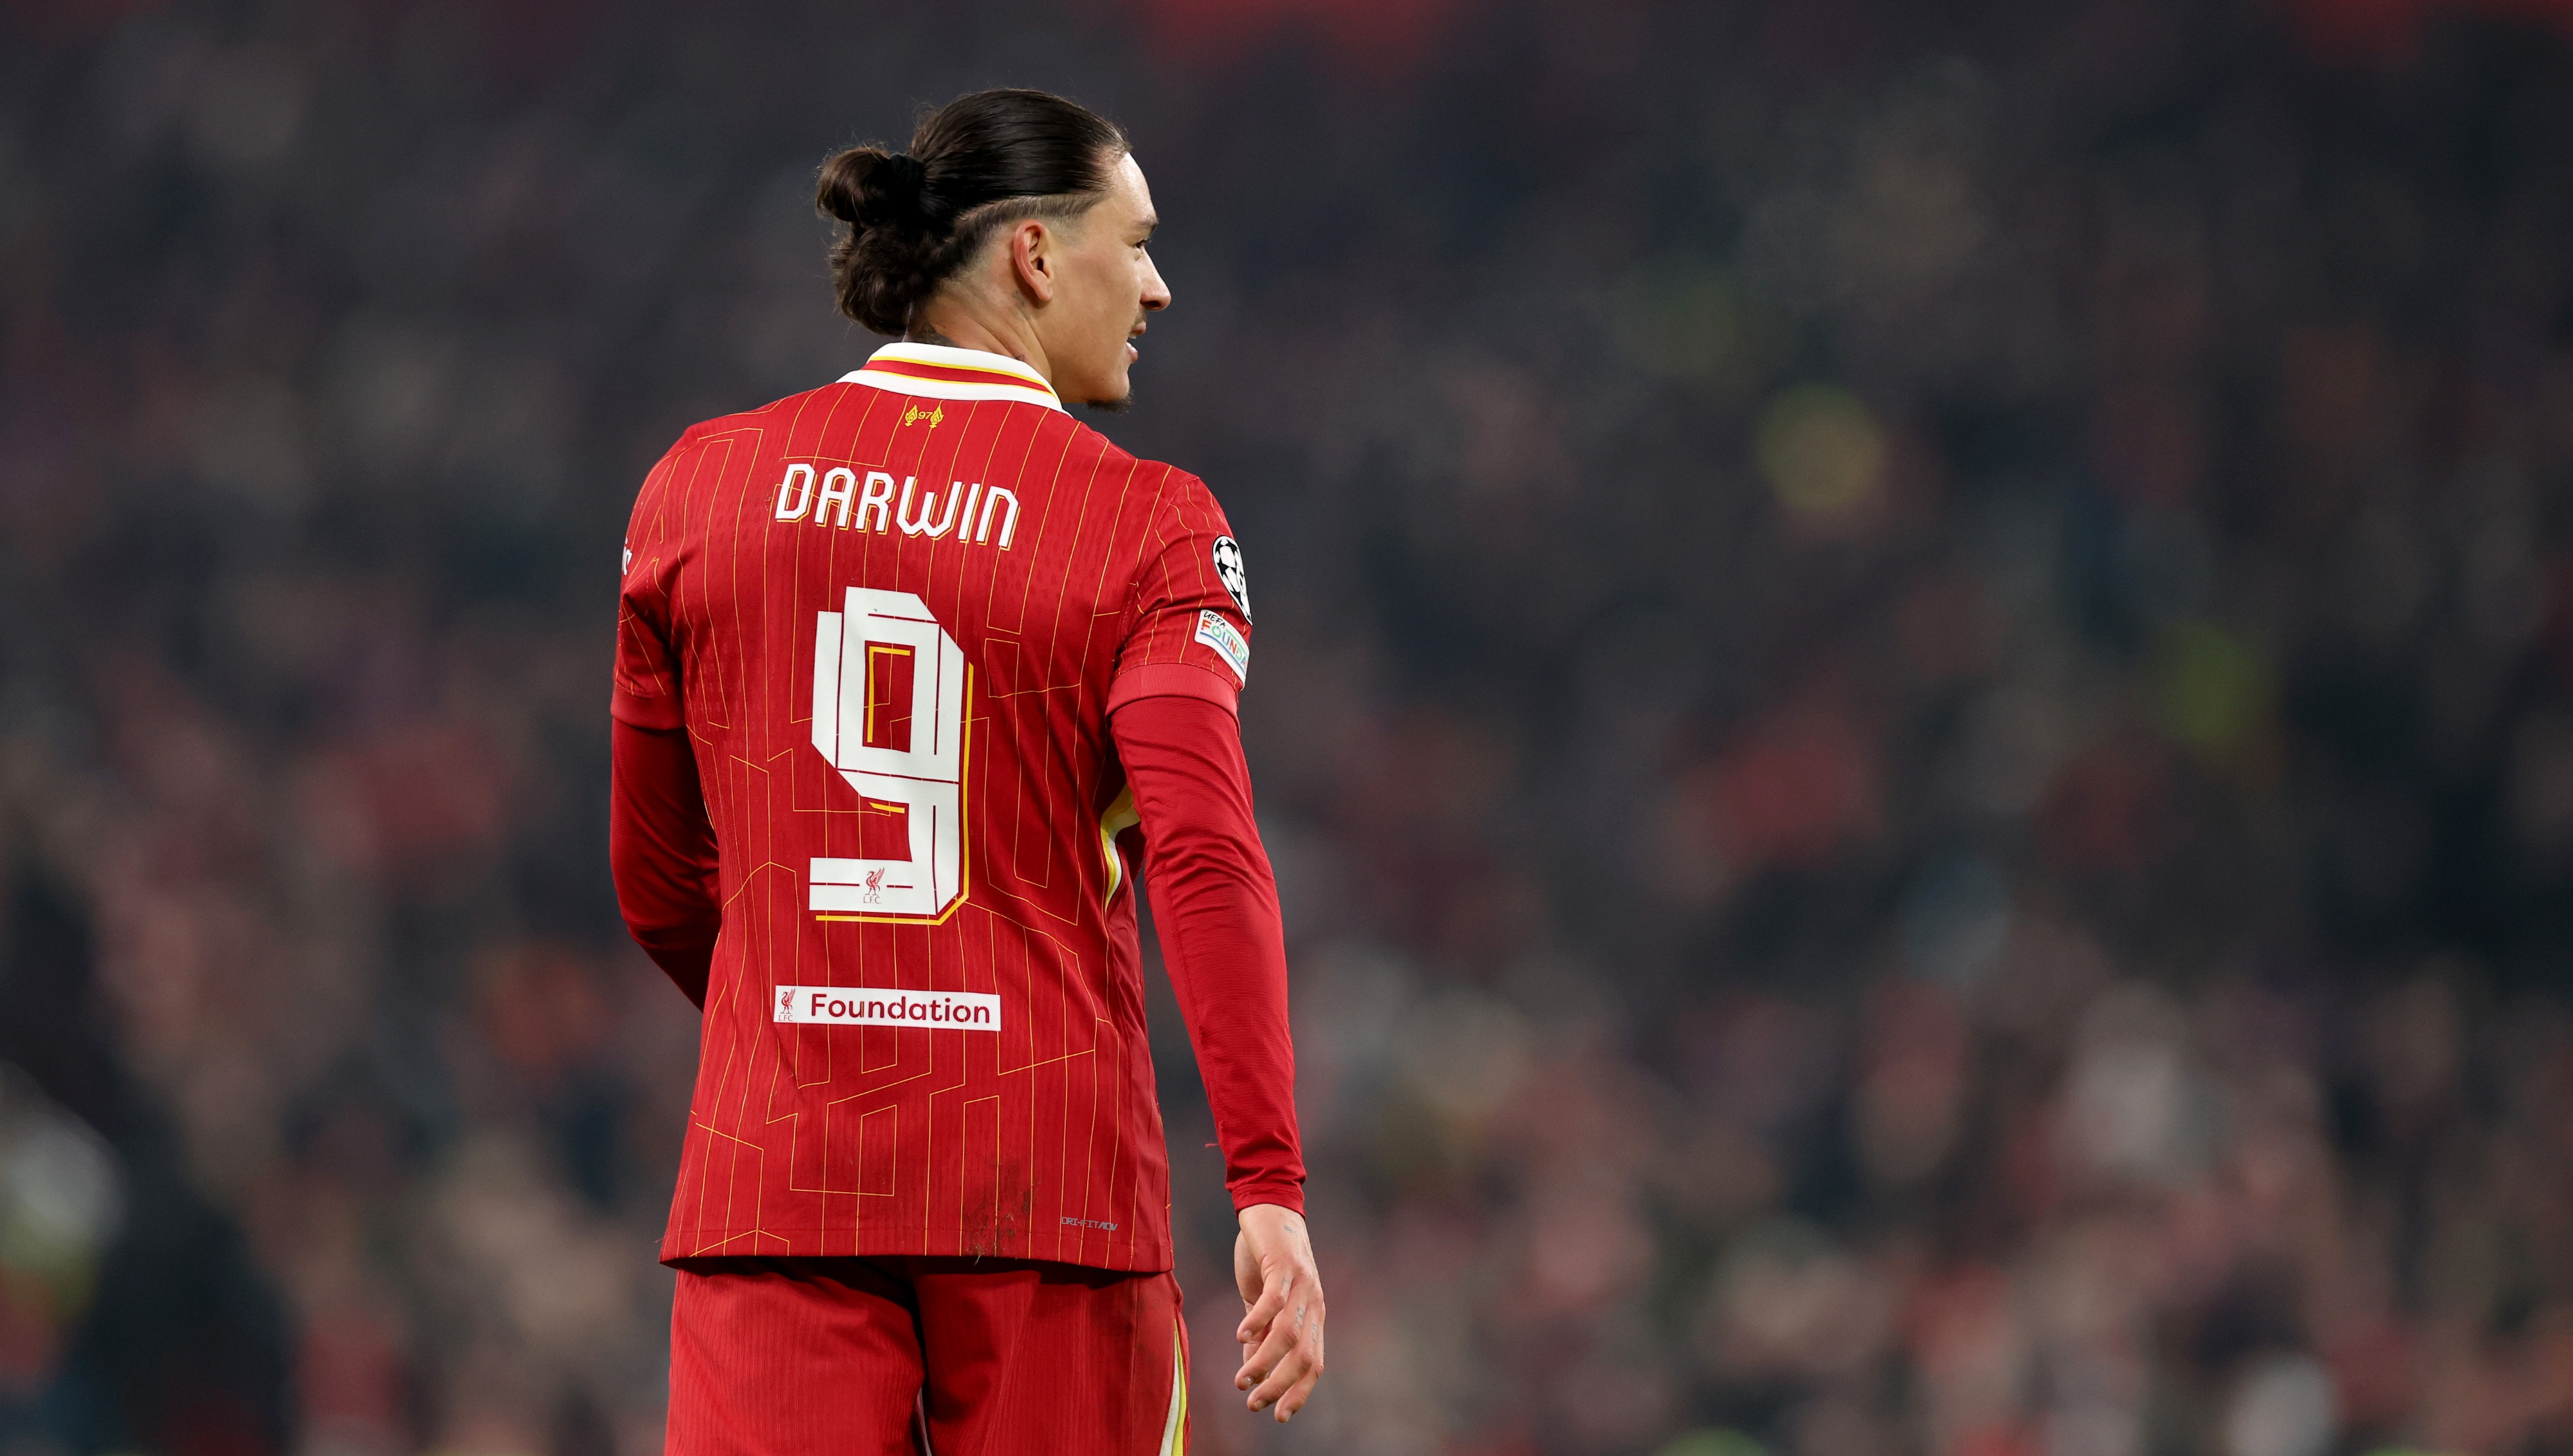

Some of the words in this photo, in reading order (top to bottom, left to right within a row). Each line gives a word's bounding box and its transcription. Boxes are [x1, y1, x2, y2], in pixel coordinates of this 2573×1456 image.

[775, 463, 1020, 551] DARWIN
[1204, 611, 1226, 628] UEFA
[809, 586, 974, 925] 9
[811, 994, 990, 1024] Foundation
